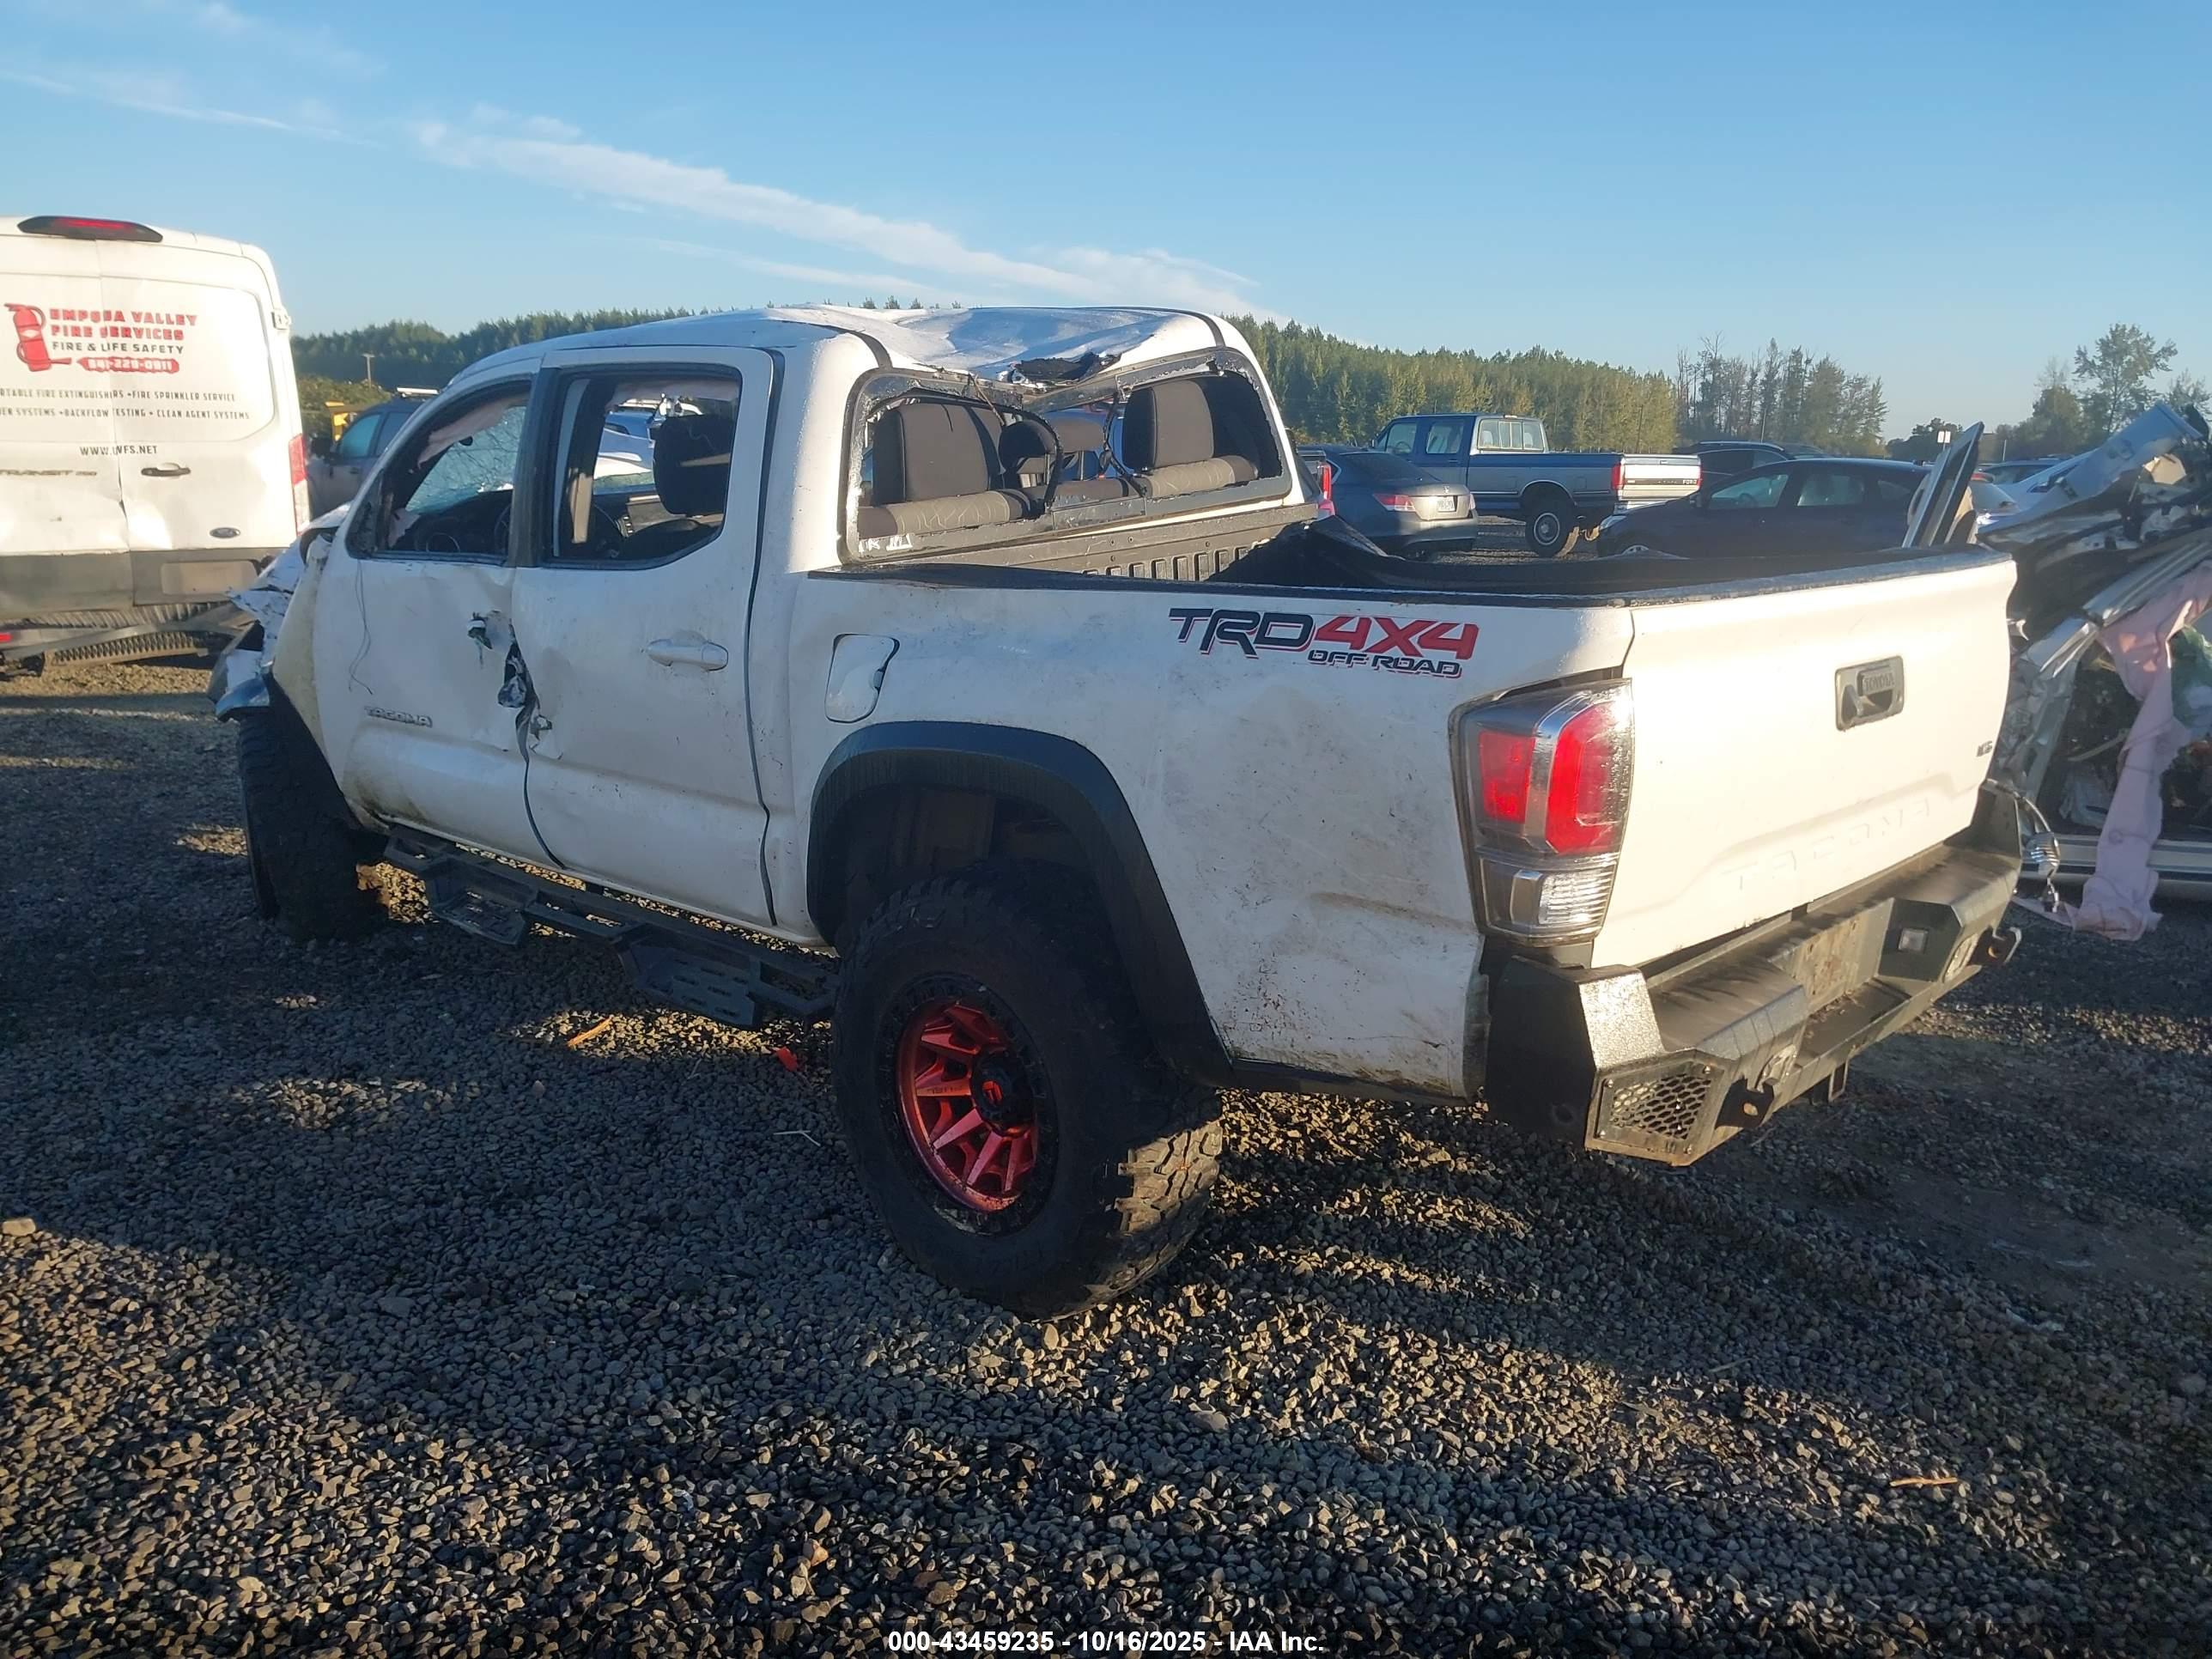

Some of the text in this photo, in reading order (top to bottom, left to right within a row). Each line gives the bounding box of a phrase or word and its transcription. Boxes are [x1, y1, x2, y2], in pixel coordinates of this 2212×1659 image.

[131, 312, 198, 325] VALLEY
[50, 325, 185, 341] FIRE SERVICES
[52, 342, 185, 355] FIRE & LIFE SAFETY
[131, 390, 151, 399] FIRE
[154, 391, 201, 401] SPRINKLER
[64, 408, 109, 417] BACKFLOW
[156, 409, 183, 418] CLEAN
[185, 410, 210, 420] AGENT
[1168, 608, 1480, 661] TRD 4X4
[1307, 648, 1462, 678] OFF ROAD
[1863, 671, 1895, 692] TOYOTA
